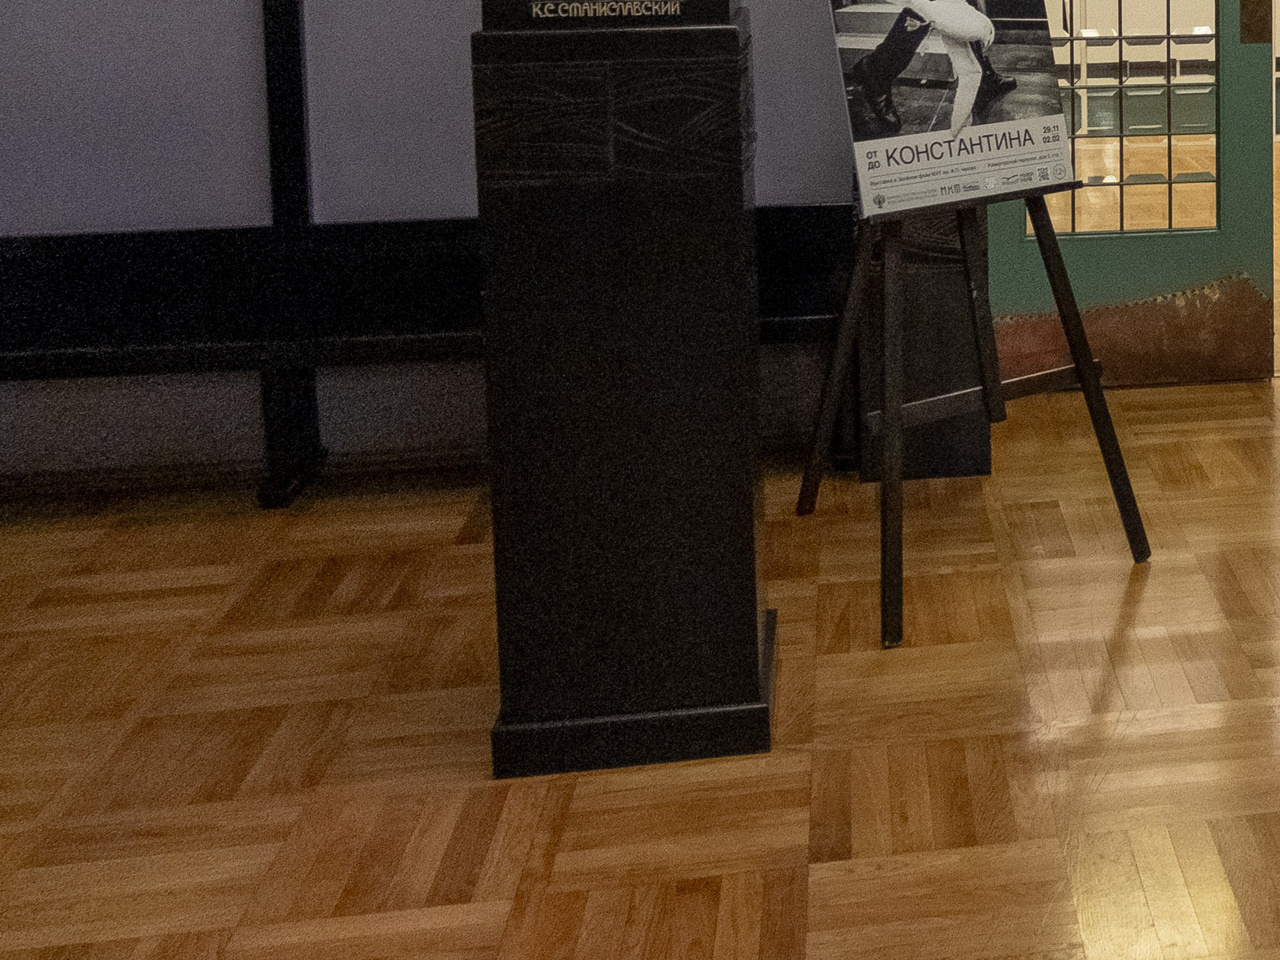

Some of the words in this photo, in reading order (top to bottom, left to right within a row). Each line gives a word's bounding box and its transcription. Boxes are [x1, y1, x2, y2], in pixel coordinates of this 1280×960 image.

[1042, 124, 1059, 133] 29.11
[1042, 134, 1060, 143] 02.02
[885, 128, 1034, 167] КОНСТАНТИНА
